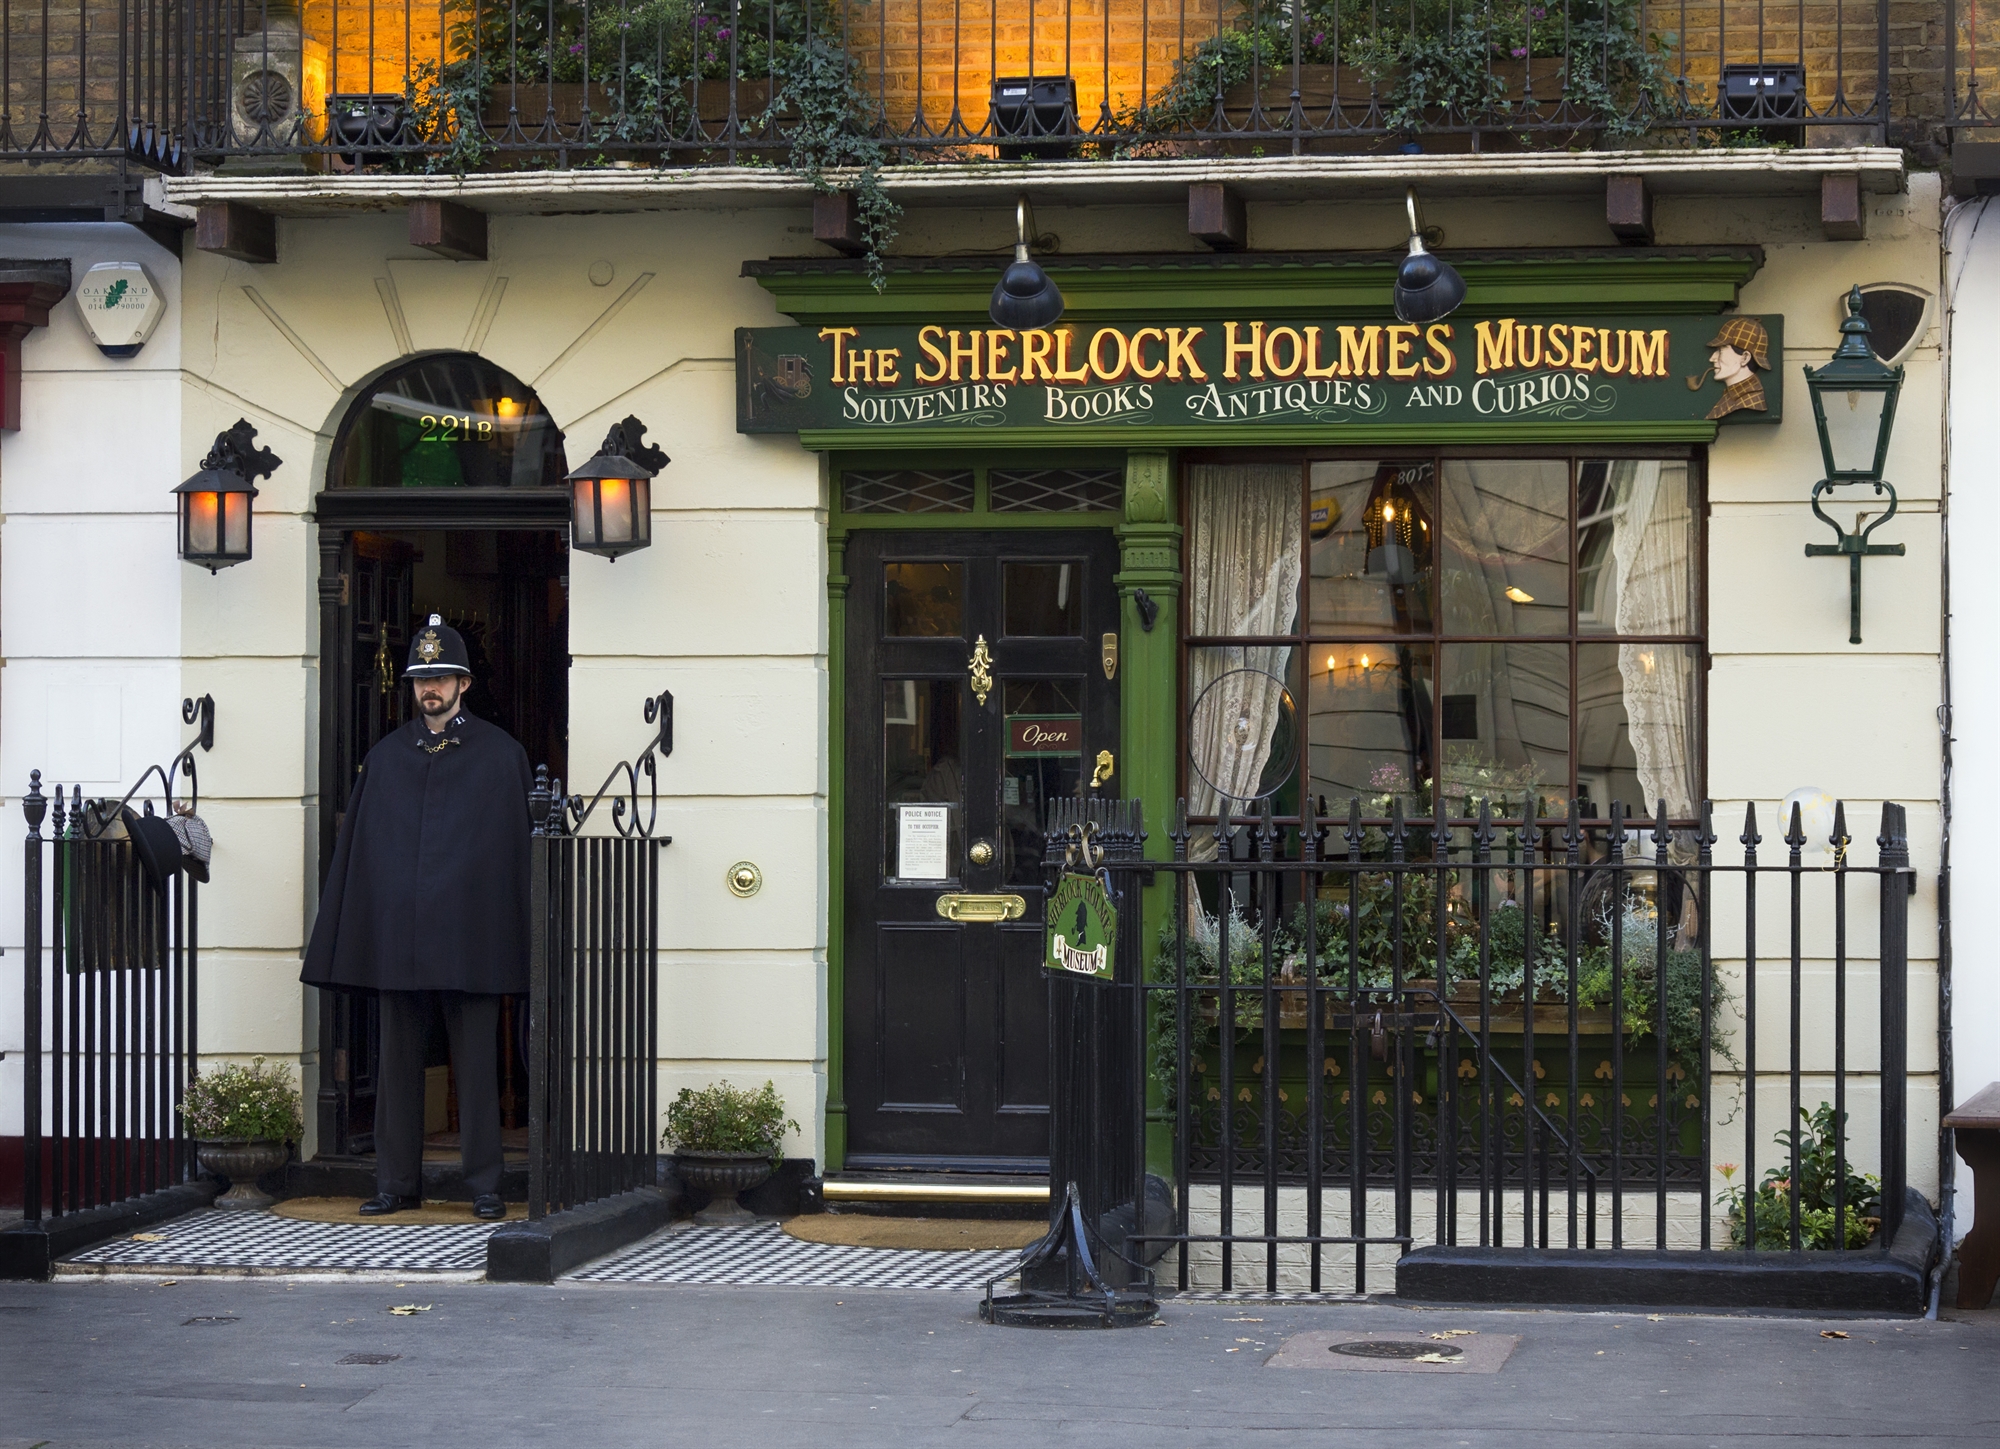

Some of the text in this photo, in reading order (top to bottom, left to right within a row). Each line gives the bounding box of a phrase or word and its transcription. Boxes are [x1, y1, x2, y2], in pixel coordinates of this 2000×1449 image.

[819, 318, 1669, 386] THE SHERLOCK HOLMES MUSEUM
[843, 373, 1590, 423] SOUVENIRS BOOKS ANTIQUES AND CURIOS
[420, 414, 493, 442] 221B
[1022, 724, 1069, 746] Open
[1048, 878, 1115, 946] SHERLOCK HOLMES
[1062, 943, 1098, 972] MUSEUM
